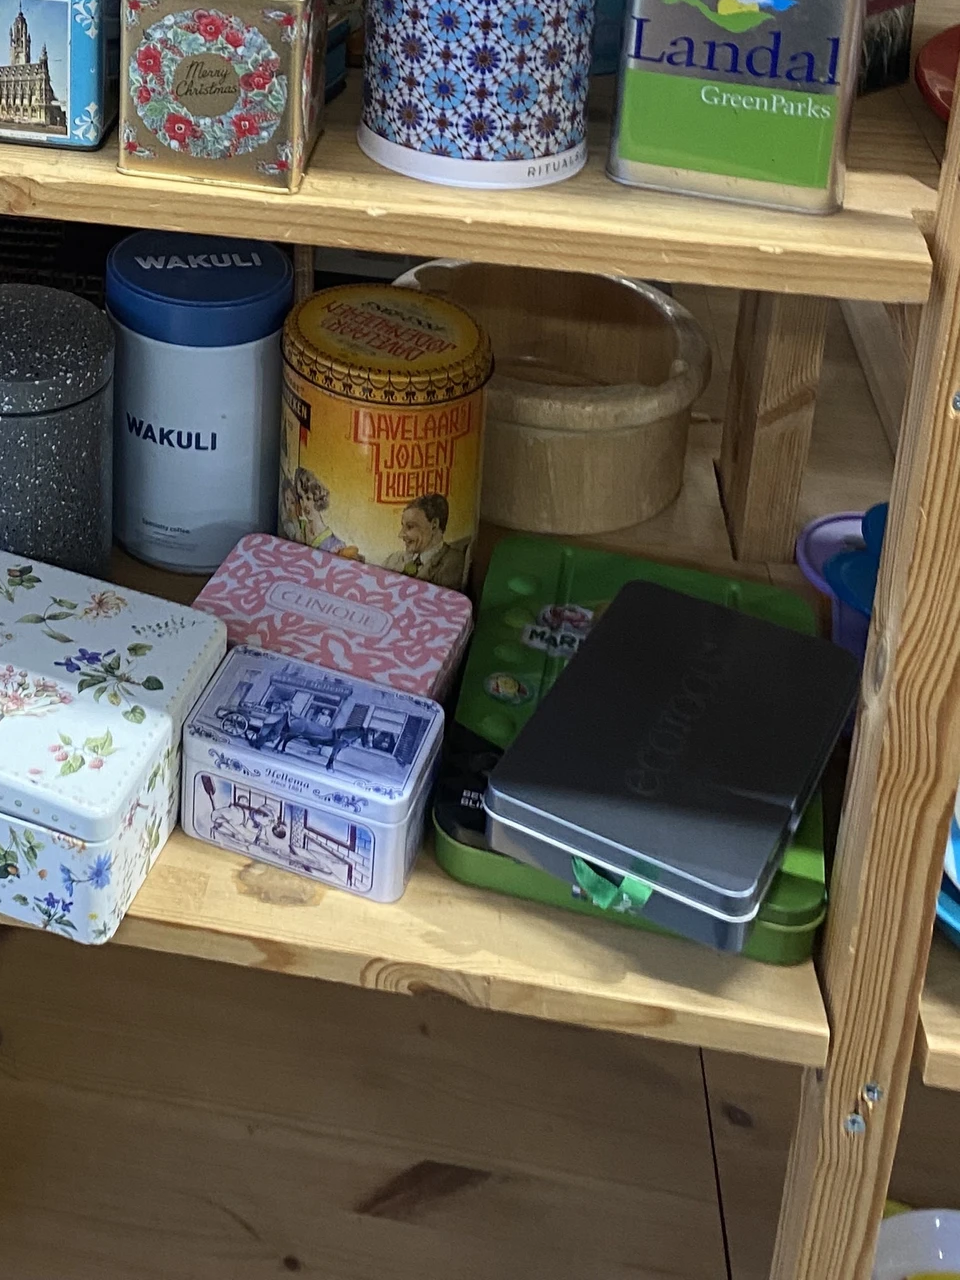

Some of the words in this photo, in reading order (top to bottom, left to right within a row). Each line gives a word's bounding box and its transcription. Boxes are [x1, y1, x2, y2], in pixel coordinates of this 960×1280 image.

[627, 15, 841, 86] Landal
[186, 60, 229, 84] Merry
[176, 80, 238, 96] Christmas
[701, 85, 831, 119] GreenParks
[527, 151, 579, 177] RITUALS
[135, 252, 263, 270] WAKULI
[126, 412, 217, 451] WAKULI
[383, 439, 448, 470] JODEN
[385, 468, 444, 498] KOEKEN
[281, 590, 372, 626] CLINIQUE
[528, 628, 577, 649] MAR
[265, 767, 310, 789] Hellema
